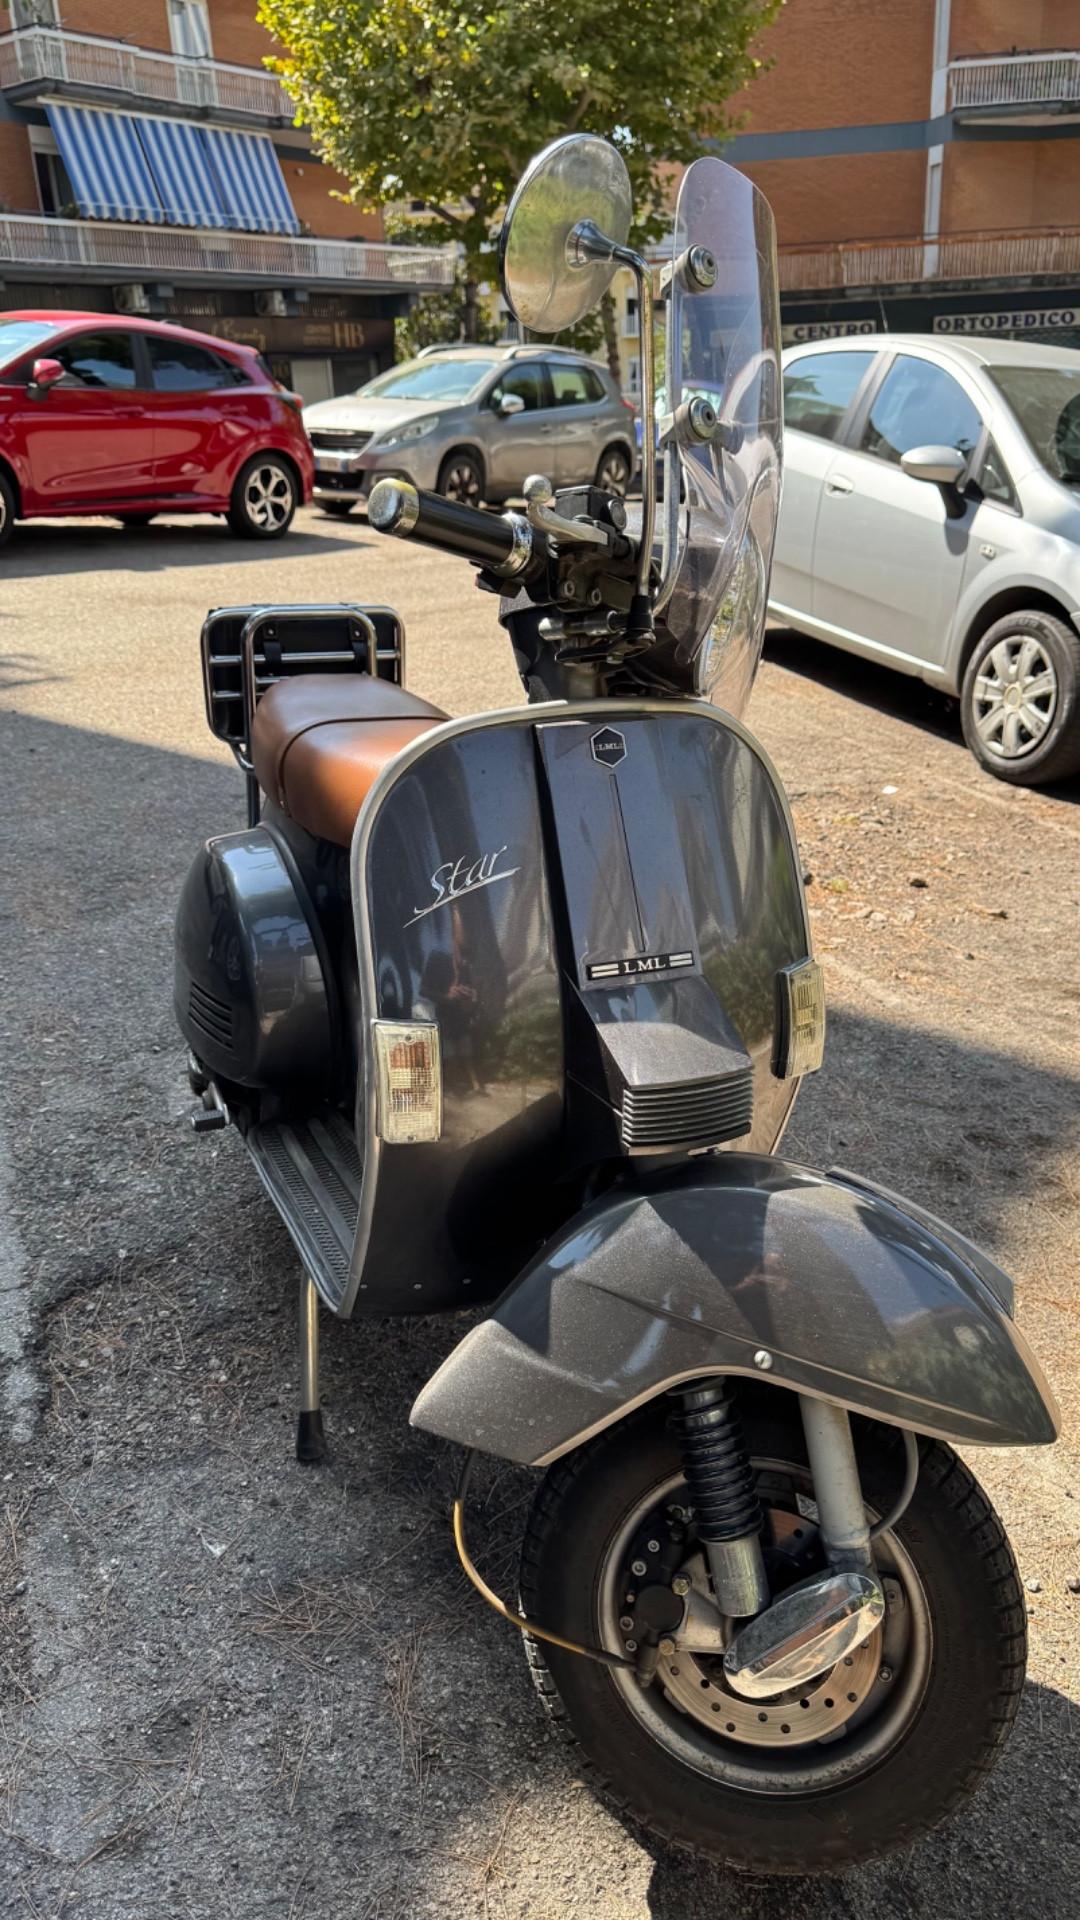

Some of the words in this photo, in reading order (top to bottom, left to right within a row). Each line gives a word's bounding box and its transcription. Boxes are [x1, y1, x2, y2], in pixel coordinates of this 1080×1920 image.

[334, 322, 365, 348] HB
[794, 322, 873, 339] CENTRO
[937, 311, 1075, 331] ORTOPEDICO
[410, 846, 514, 918] Star
[623, 958, 666, 973] LML
